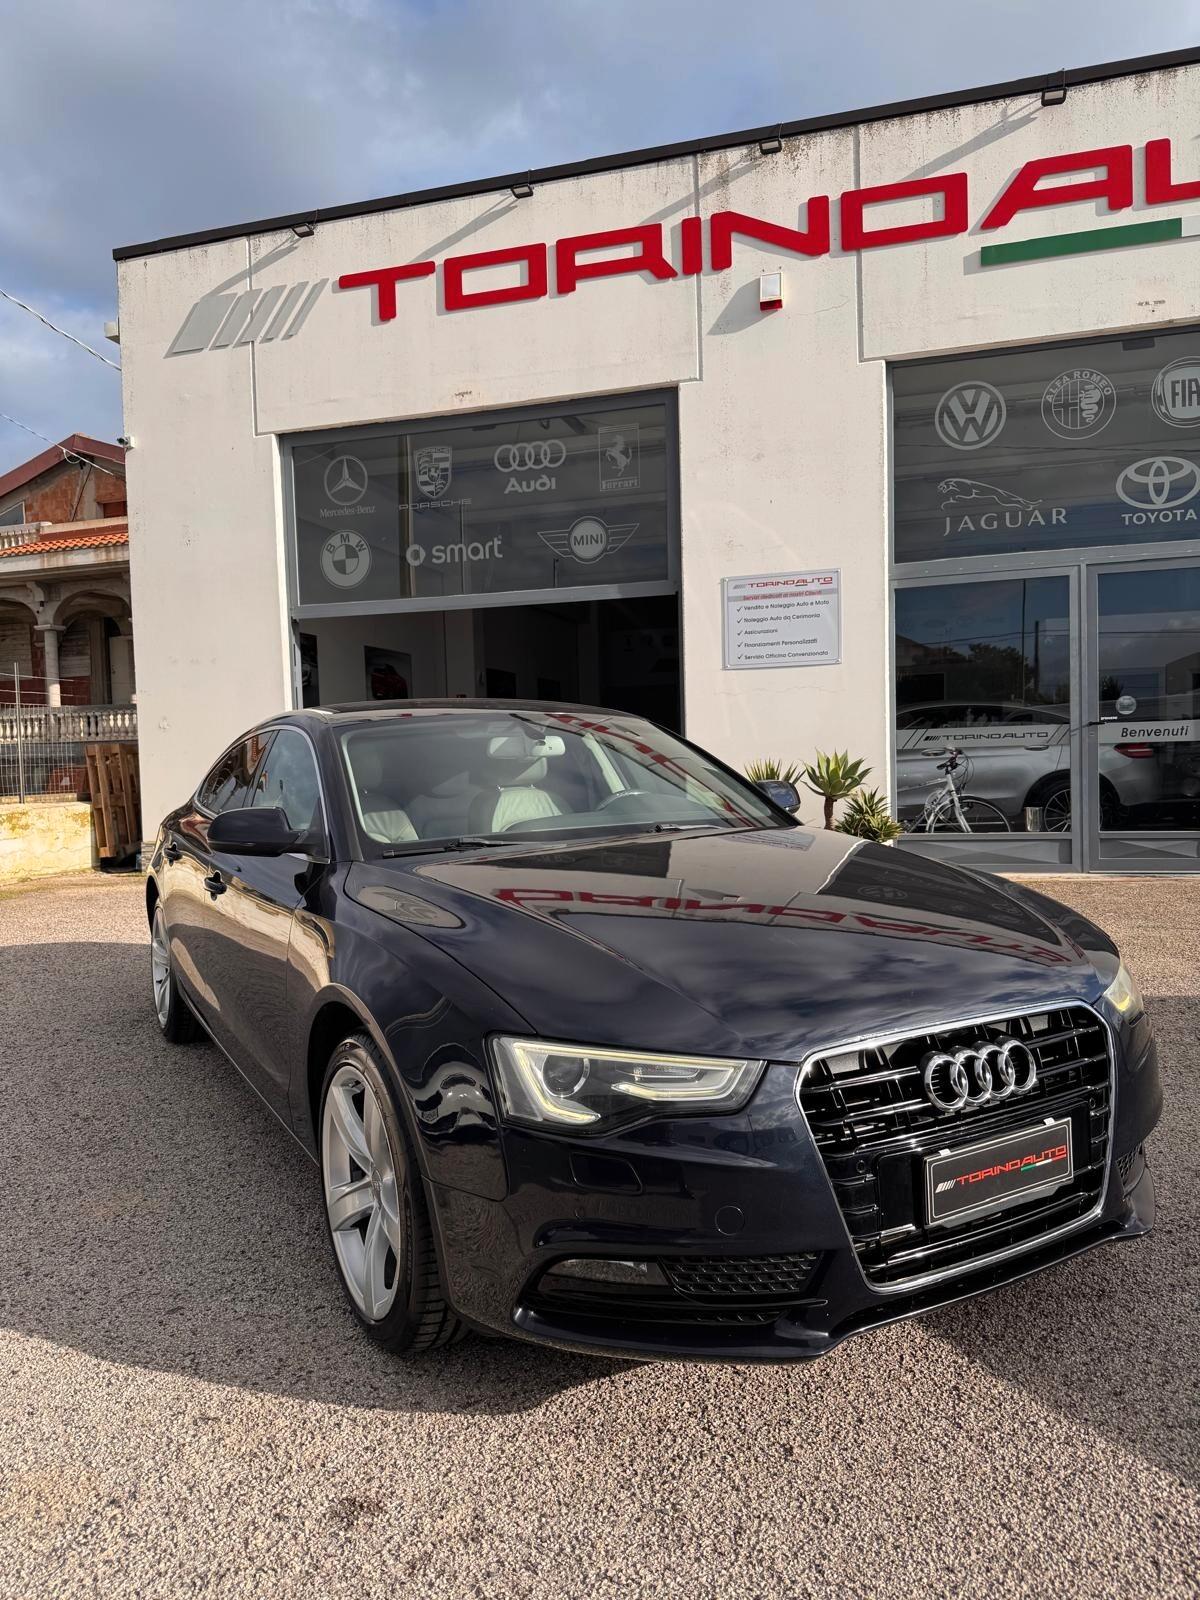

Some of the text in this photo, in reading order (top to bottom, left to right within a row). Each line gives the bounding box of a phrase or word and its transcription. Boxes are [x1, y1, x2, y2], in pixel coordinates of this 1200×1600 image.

[1046, 369, 1113, 402] ALFA ROMEO
[504, 474, 556, 494] Audi
[319, 504, 377, 519] Mercedes-Benz
[399, 498, 472, 511] PORSCHE
[943, 507, 1067, 536] JAGUAR
[1121, 509, 1197, 526] TOYOTA
[325, 532, 367, 554] BMW
[573, 533, 602, 546] MINI
[432, 536, 502, 563] smart
[748, 577, 832, 588] TORINOAUTO
[942, 731, 1049, 741] TORINOAUTO
[1120, 725, 1190, 738] Benvenuti
[956, 1144, 1067, 1186] TORINOAUTO
